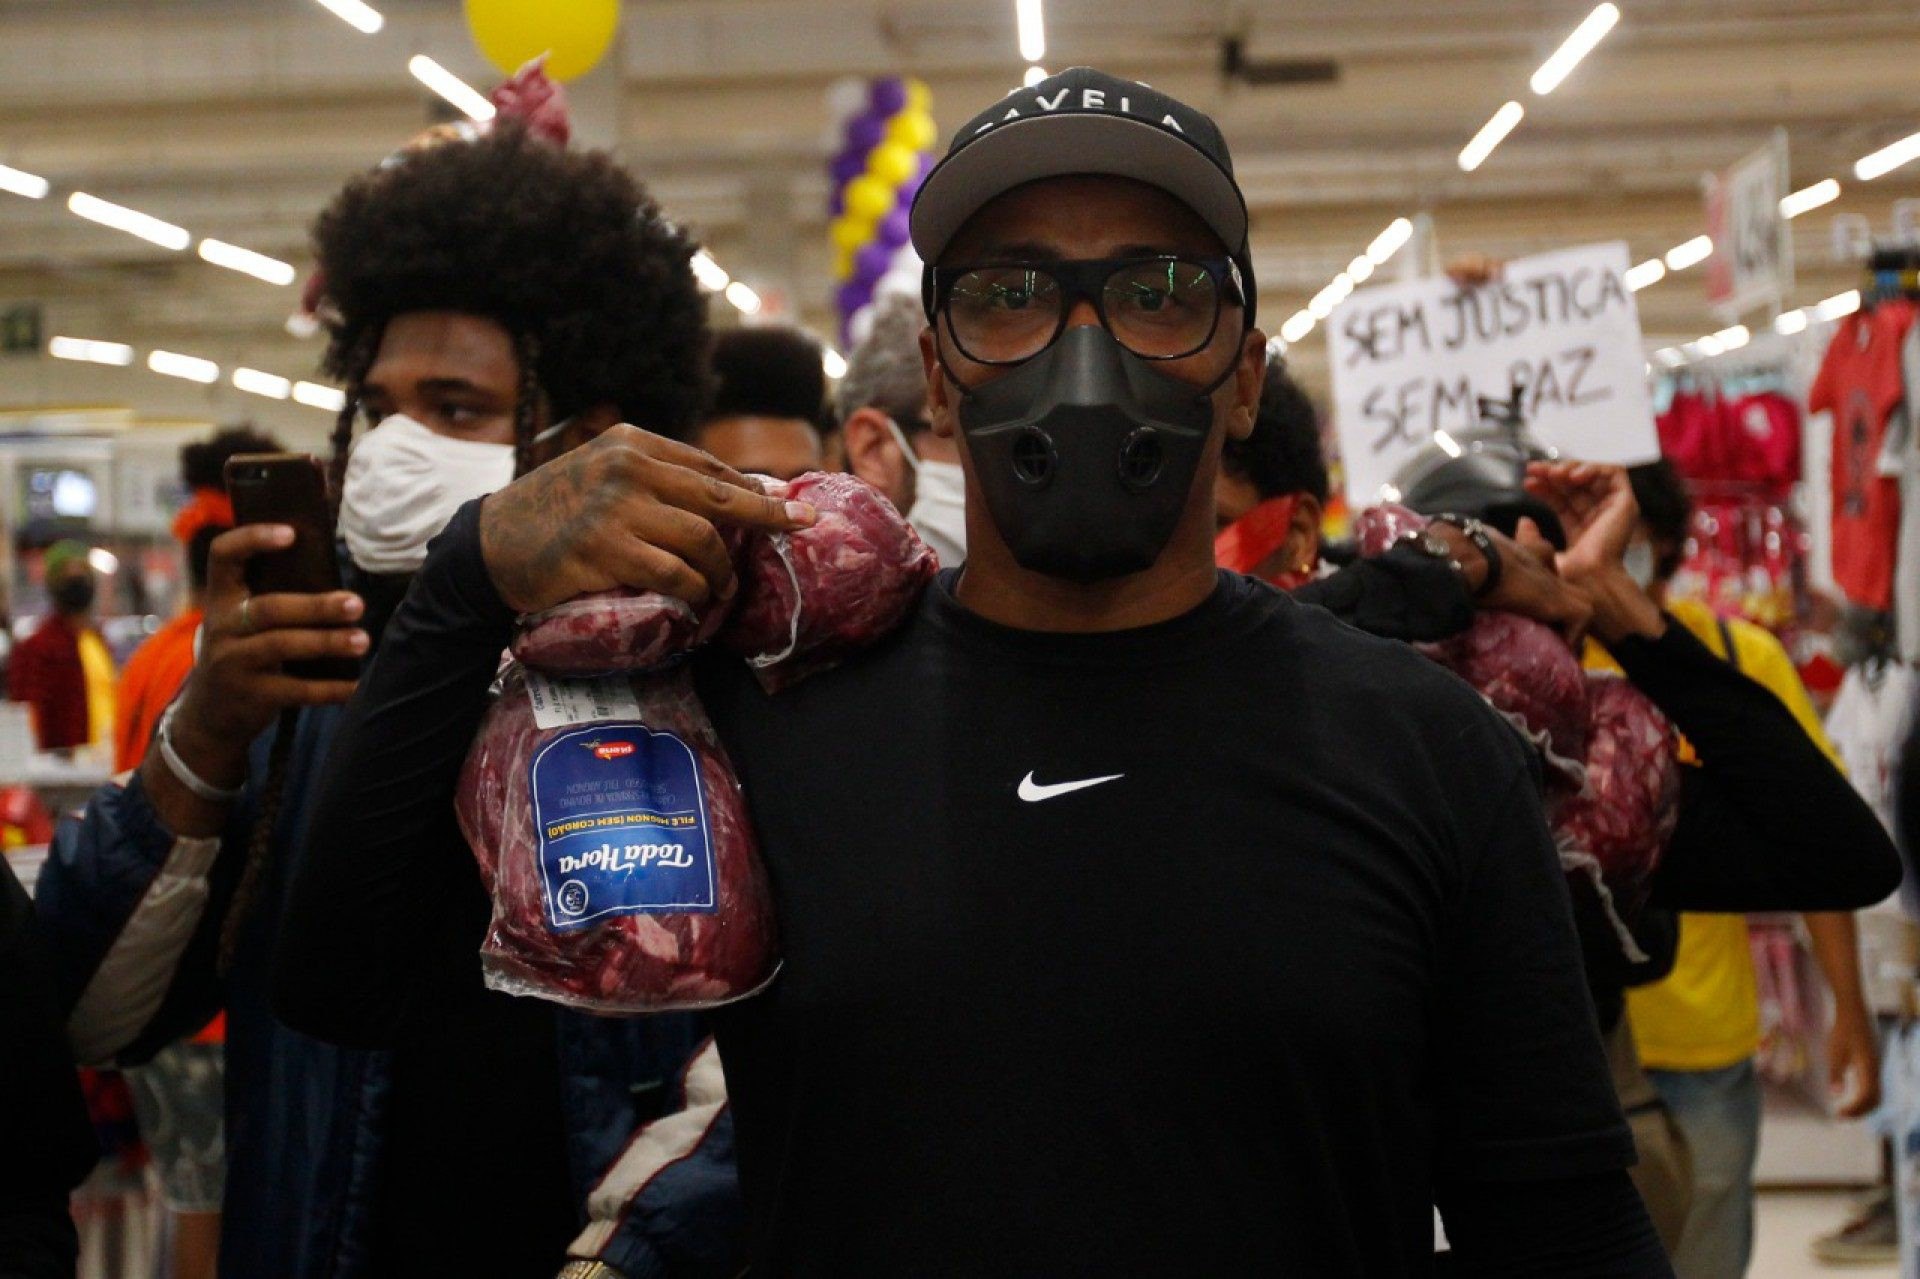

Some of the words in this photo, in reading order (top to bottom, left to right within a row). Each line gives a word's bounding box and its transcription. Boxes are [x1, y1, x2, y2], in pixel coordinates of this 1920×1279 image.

[974, 87, 1184, 133] AVELA
[1344, 303, 1430, 368] SEM
[1361, 374, 1472, 453] SEM
[626, 814, 669, 827] MIGNON
[672, 815, 696, 826] FILÉ
[559, 843, 635, 874] Hora
[624, 844, 693, 868] Toda
